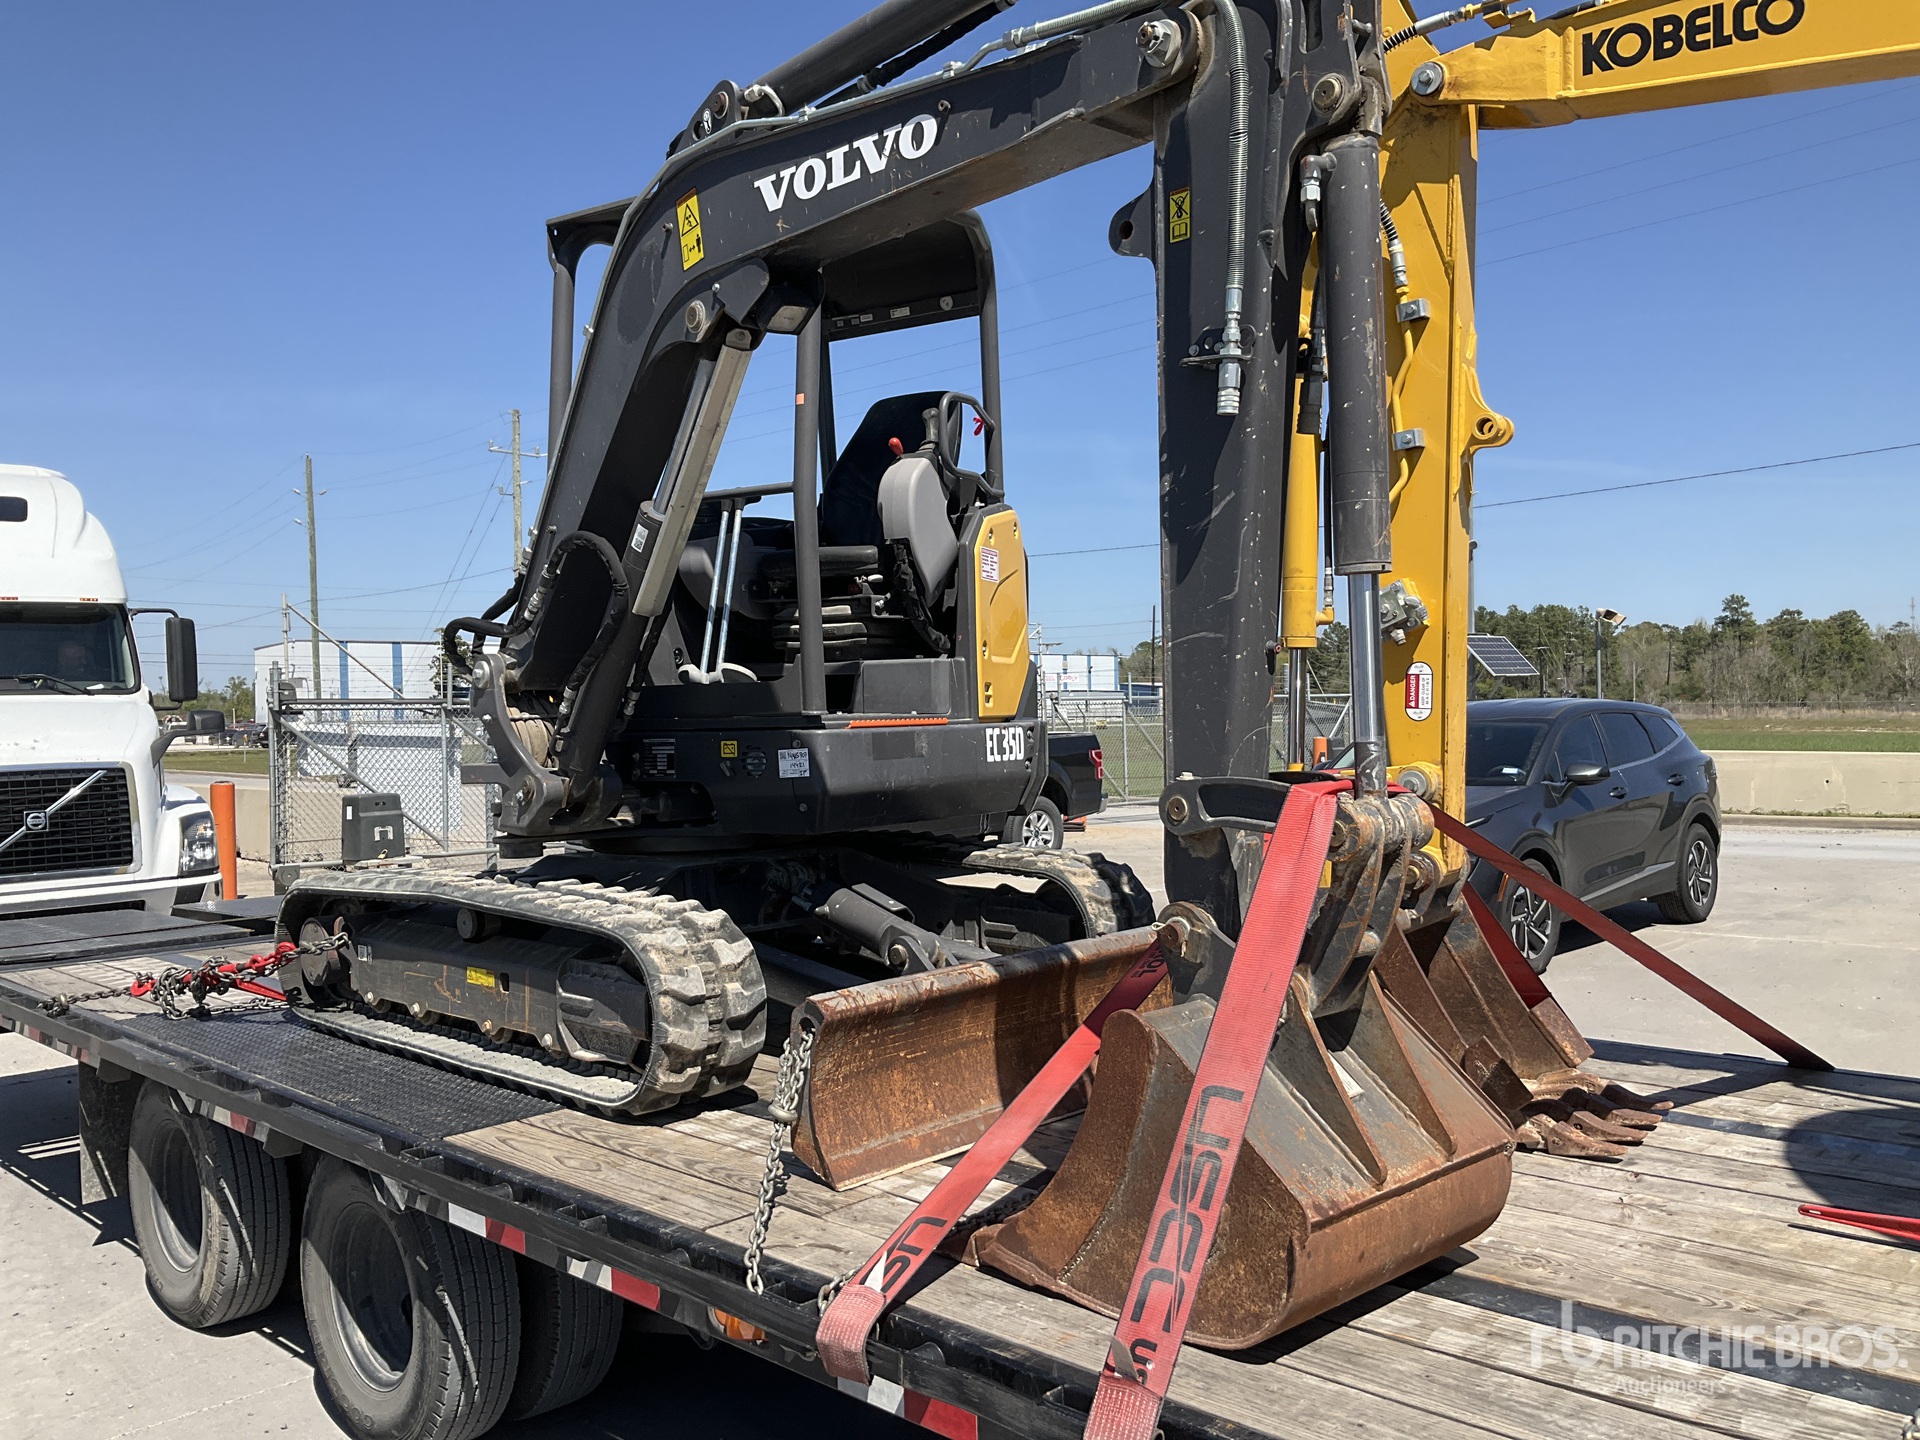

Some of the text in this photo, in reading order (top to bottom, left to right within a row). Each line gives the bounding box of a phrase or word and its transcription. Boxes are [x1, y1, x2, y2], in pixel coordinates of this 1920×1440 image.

[1582, 0, 1805, 76] KOBELCO
[754, 114, 938, 212] VOLVO
[985, 726, 1025, 762] EC35D
